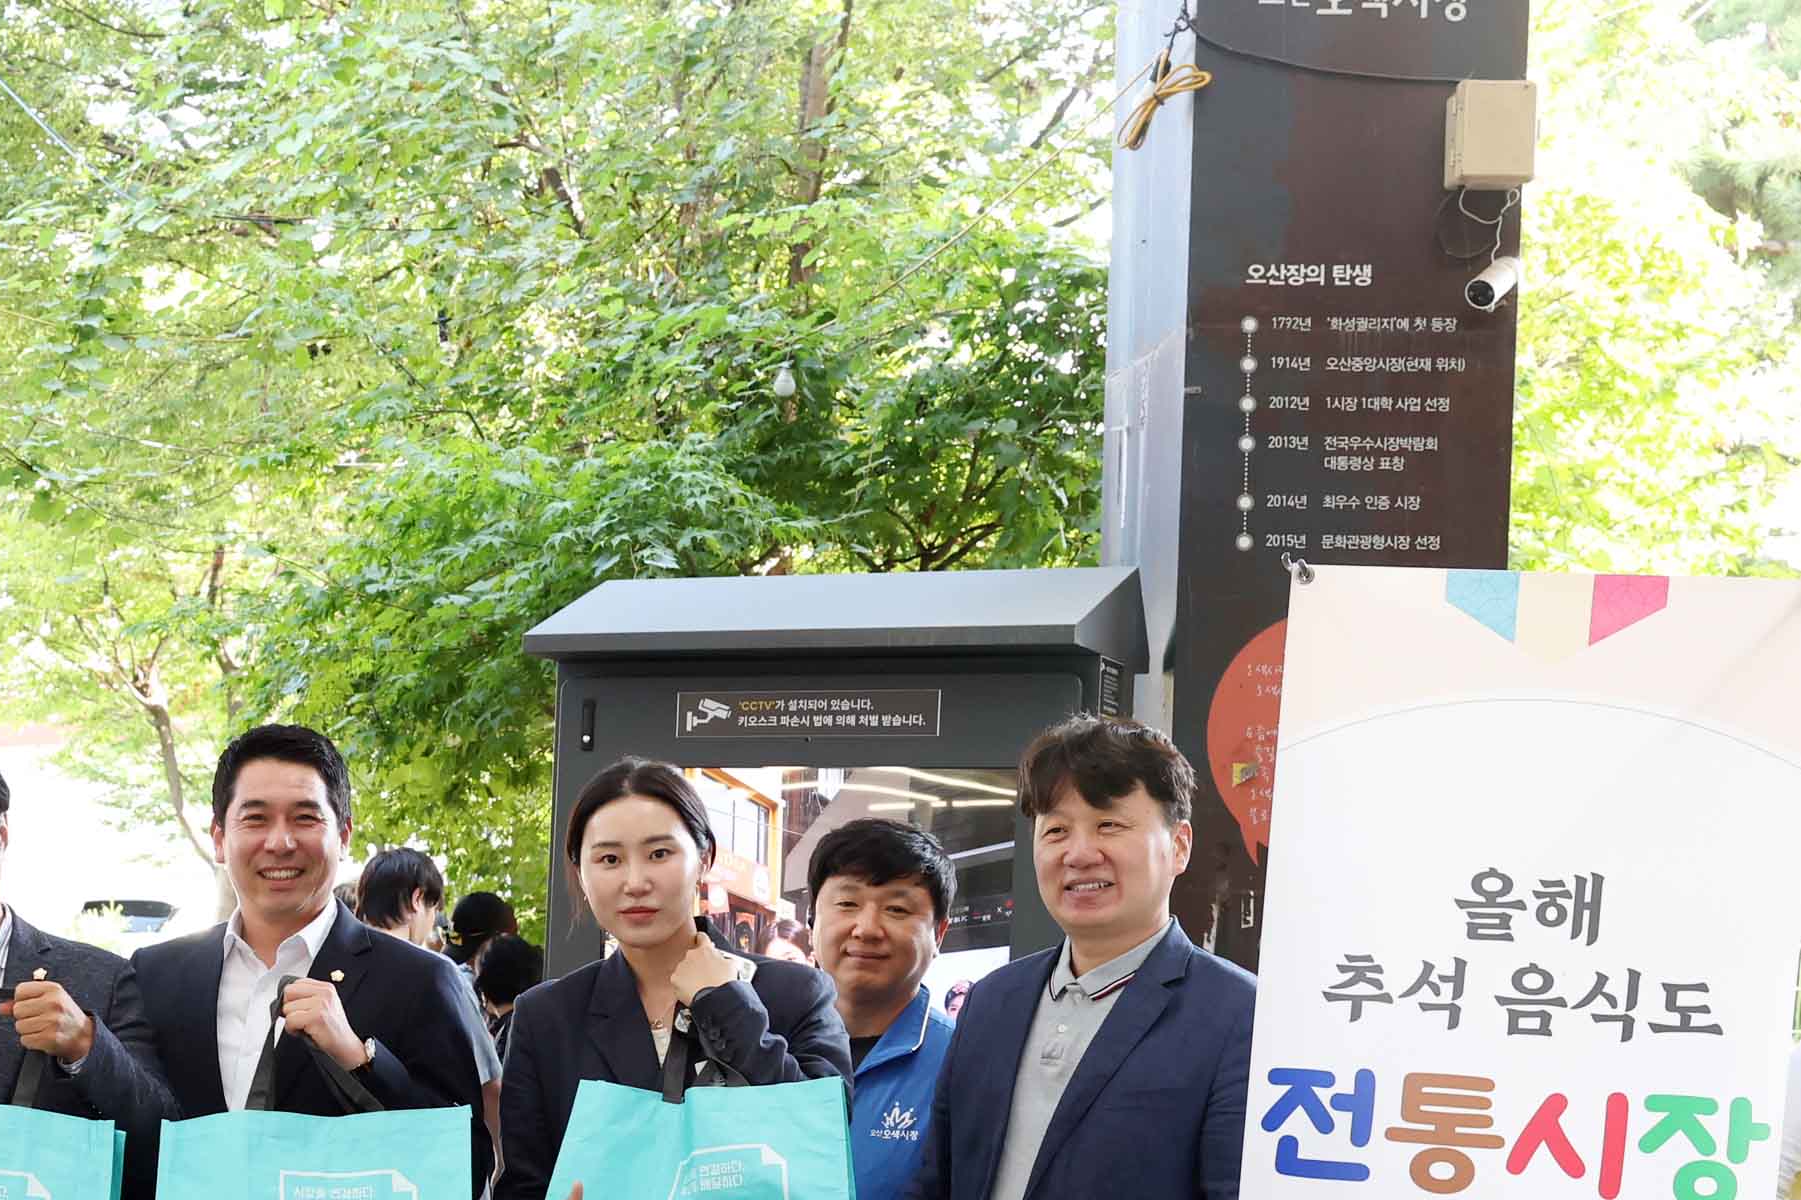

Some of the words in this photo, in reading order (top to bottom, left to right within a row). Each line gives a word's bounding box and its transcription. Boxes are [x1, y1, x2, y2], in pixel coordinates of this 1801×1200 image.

[1245, 263, 1326, 286] 오산장의
[1332, 263, 1373, 287] 탄생
[1272, 317, 1312, 332] 1792년
[1413, 317, 1427, 332] 첫
[1430, 317, 1457, 332] 등장
[1271, 356, 1311, 371] 1914년
[1326, 357, 1431, 373] 오산중앙시장(현재
[1435, 357, 1466, 373] 위치)
[1269, 396, 1310, 411] 2012년
[1326, 396, 1357, 411] 1시장
[1362, 397, 1392, 411] 1대학
[1397, 397, 1421, 411] 사업
[1424, 397, 1450, 412] 선정
[1268, 435, 1309, 450] 2013년
[1324, 436, 1438, 452] 전국우수시장박람회
[1324, 456, 1374, 471] 대통령상
[1378, 456, 1405, 472] 표창
[1267, 494, 1307, 509] 2014년
[1322, 495, 1360, 510] 최우수
[1364, 495, 1390, 510] 인증
[1394, 495, 1421, 511] 시장
[1266, 534, 1306, 549] 2015년
[1321, 534, 1410, 550] 문화관광형시장
[1415, 535, 1440, 551] 선정
[788, 699, 827, 712] 설치되어
[830, 699, 874, 712] 있습니다.
[737, 715, 777, 727] 키오스크
[780, 714, 810, 727] 파손시
[813, 714, 832, 727] 법에
[835, 714, 855, 727] 의해
[859, 714, 878, 727] 처벌
[882, 714, 926, 727] 받습니다.
[1454, 866, 1606, 948] 올해
[1322, 954, 1468, 1031] 추석
[1495, 962, 1725, 1043] 음식도
